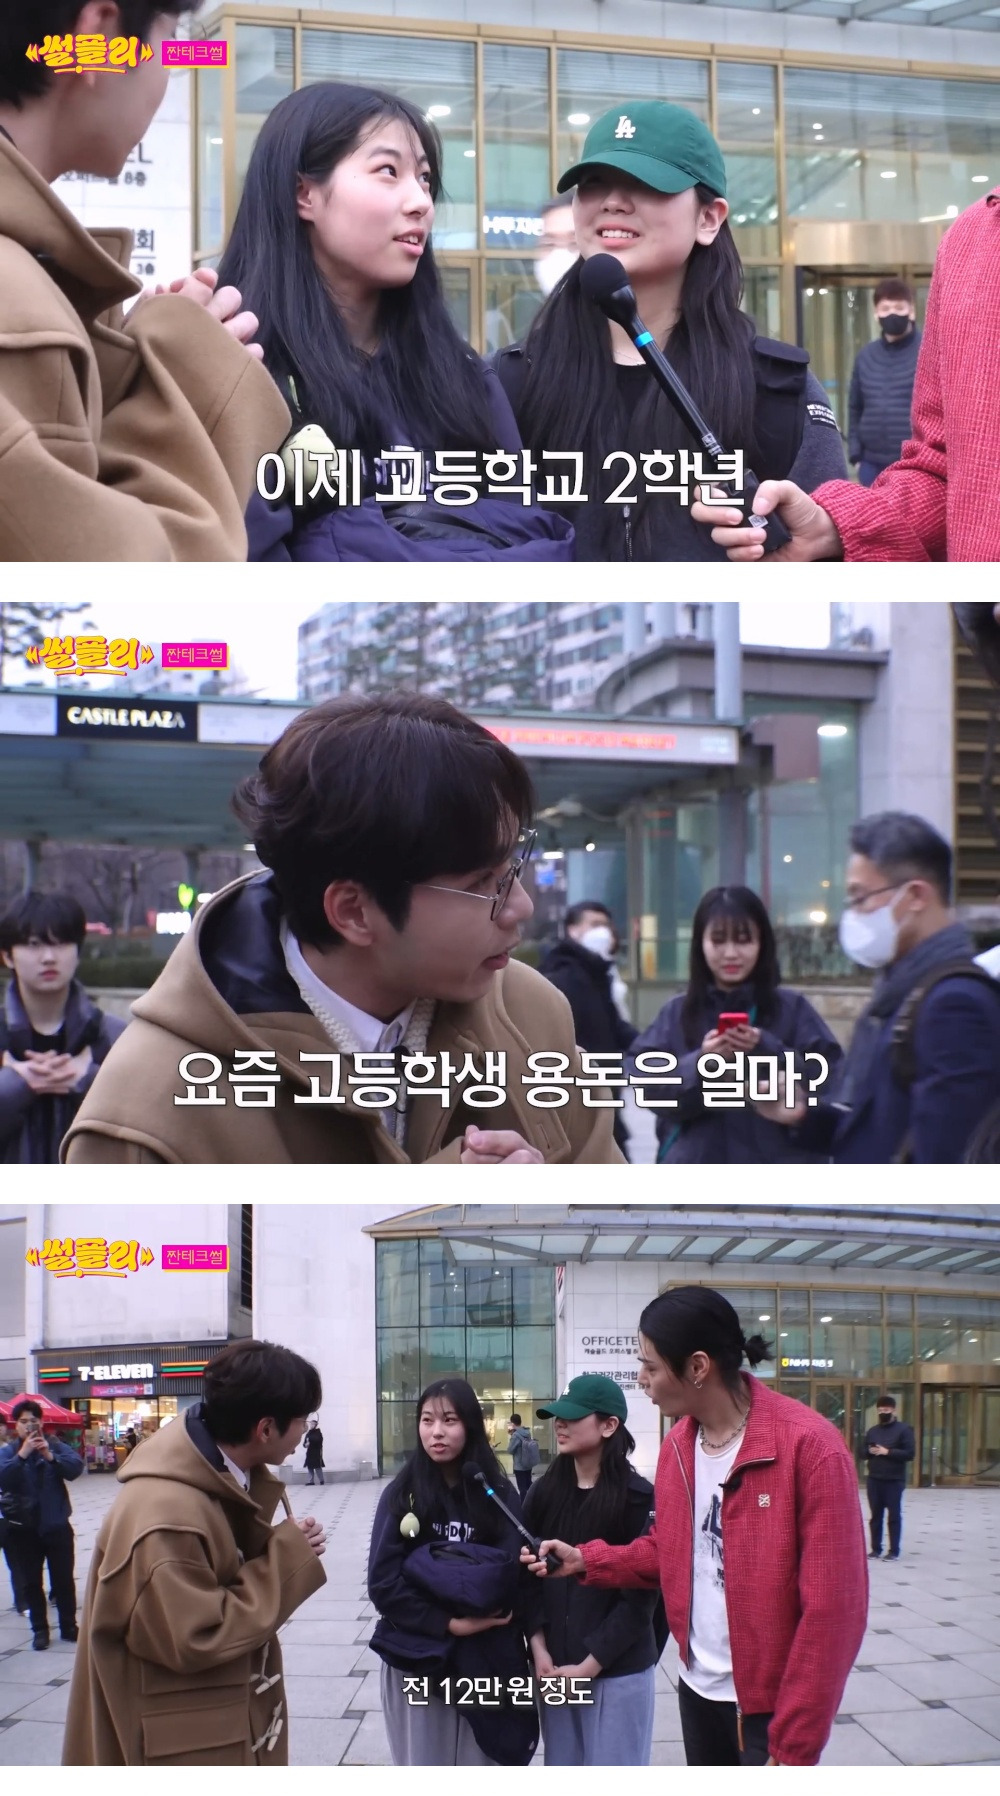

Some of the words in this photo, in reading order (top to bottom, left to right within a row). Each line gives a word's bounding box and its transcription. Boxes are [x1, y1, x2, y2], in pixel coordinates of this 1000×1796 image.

[67, 706, 129, 726] CASTLE
[130, 709, 185, 729] PLAZA
[581, 1336, 639, 1346] OFFICETE
[78, 1363, 154, 1382] 7-ELEVEN
